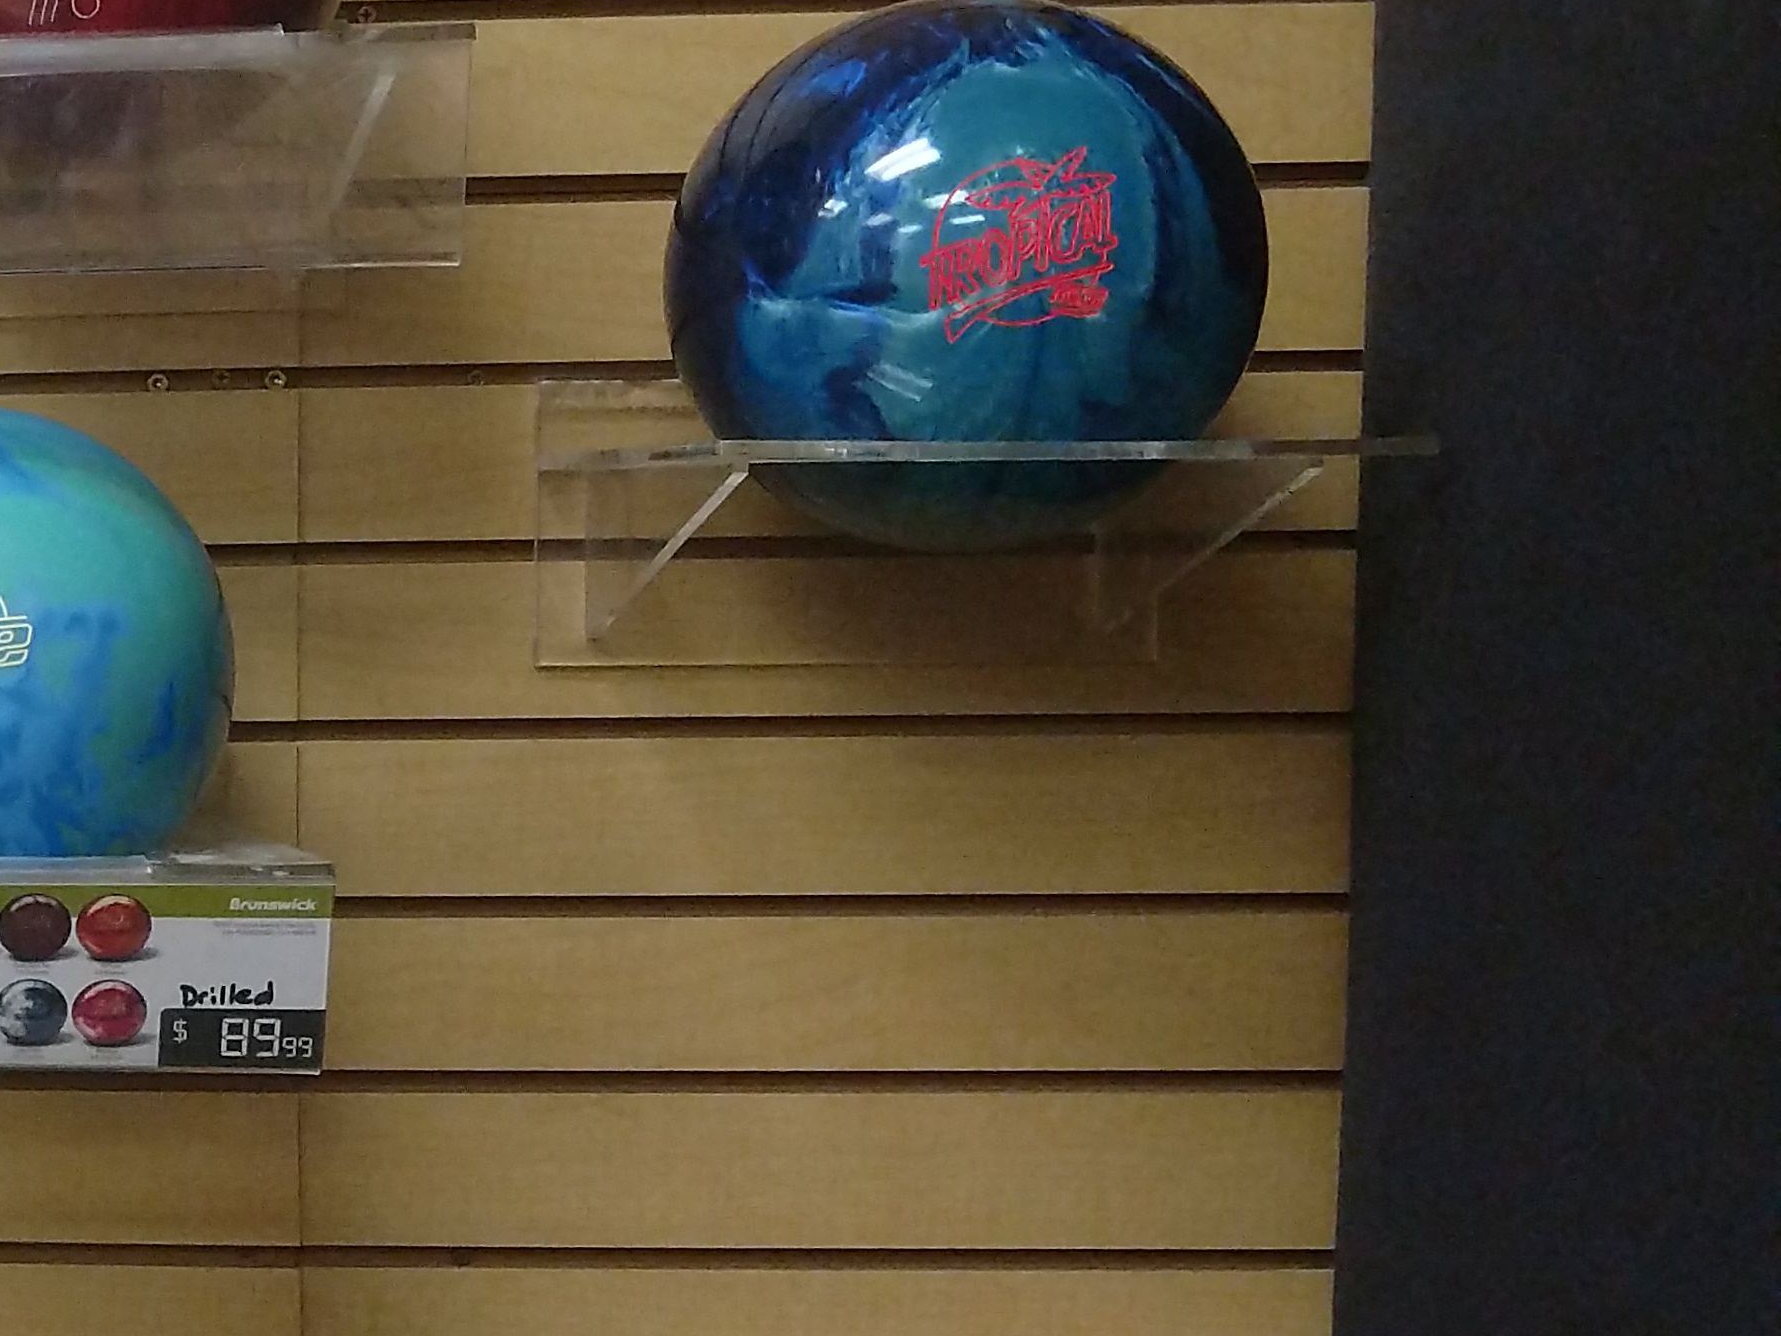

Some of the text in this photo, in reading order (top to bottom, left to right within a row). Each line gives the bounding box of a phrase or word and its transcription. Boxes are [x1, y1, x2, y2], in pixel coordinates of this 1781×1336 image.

[920, 187, 1118, 311] TROPICAL
[229, 897, 318, 911] Brunswick
[180, 980, 274, 1007] Drilled
[173, 1018, 187, 1043] $
